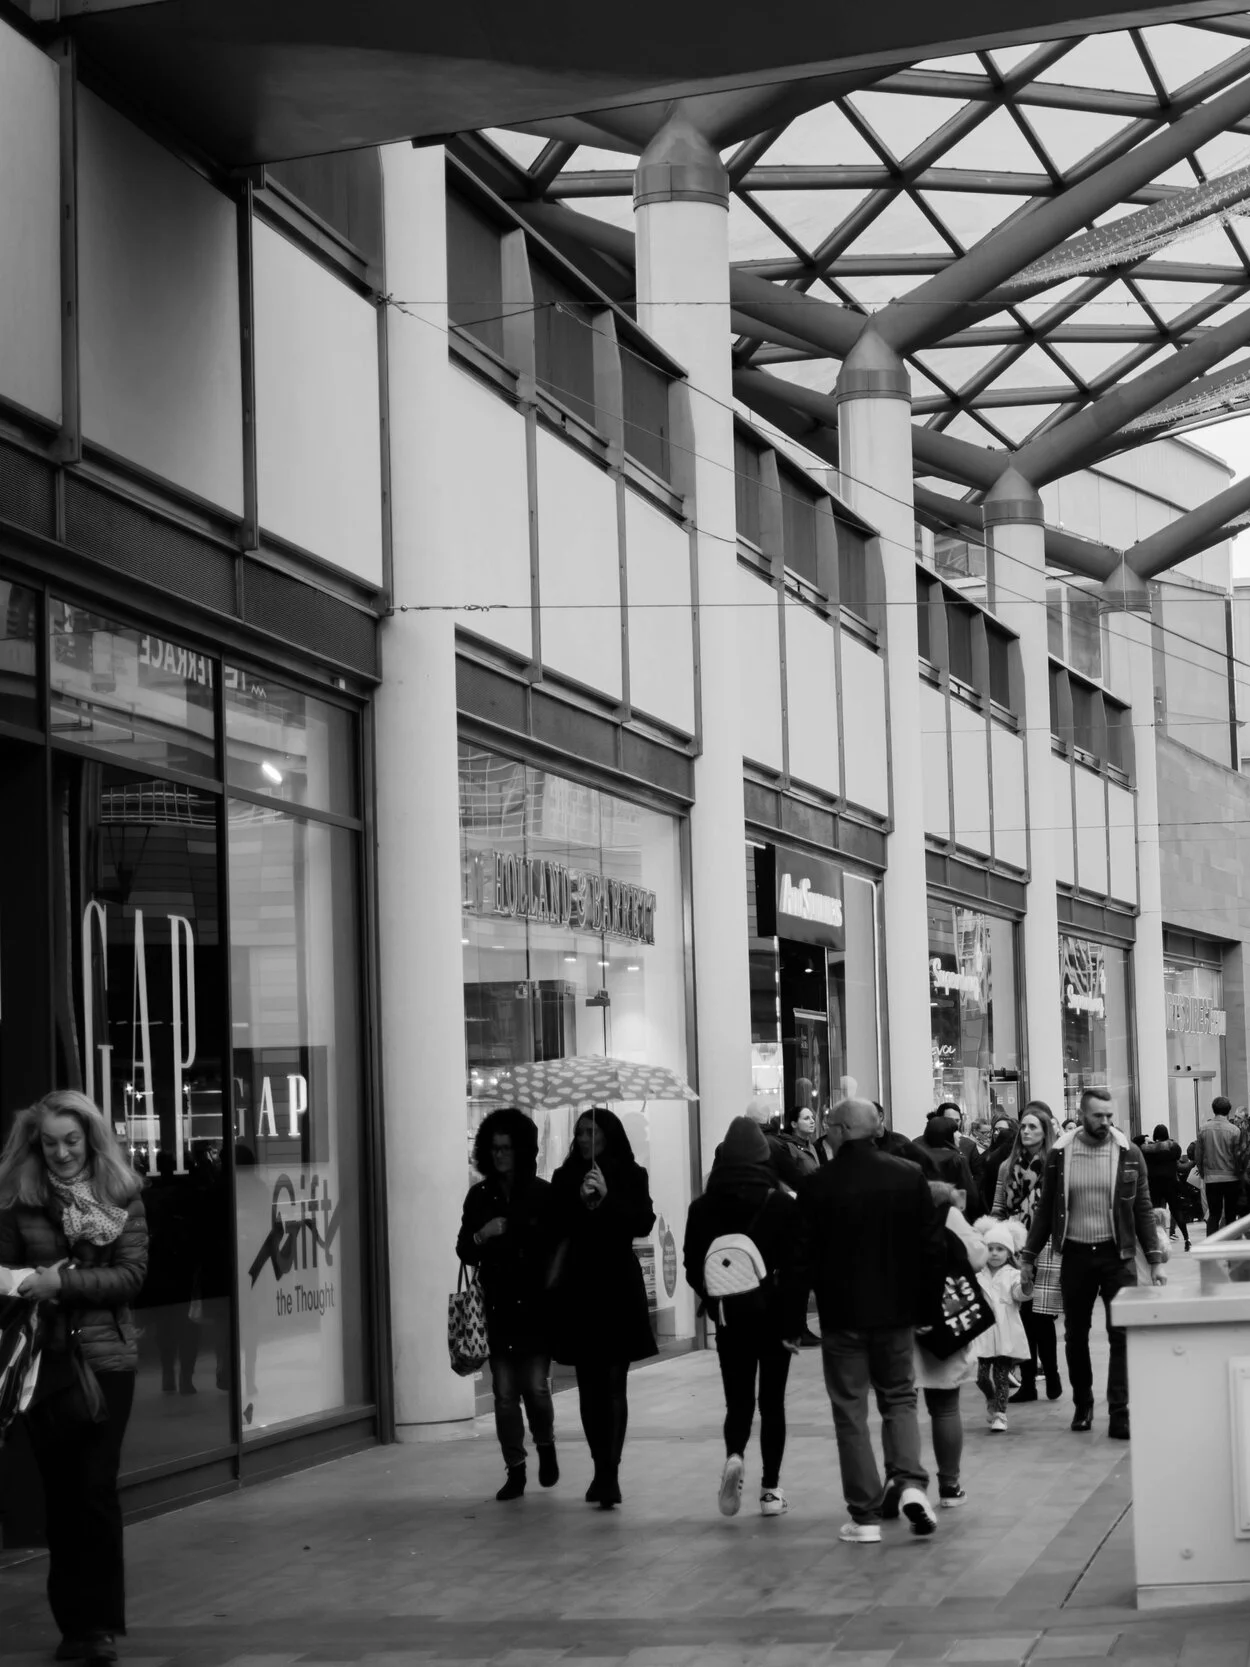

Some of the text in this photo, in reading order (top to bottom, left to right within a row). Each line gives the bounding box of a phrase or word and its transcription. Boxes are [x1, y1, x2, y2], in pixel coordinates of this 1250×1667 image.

[493, 850, 572, 926] HOLLAND
[591, 873, 657, 947] BARRETT
[83, 900, 197, 1177] GAP
[232, 1074, 308, 1137] GAP
[271, 1173, 332, 1275] Gift
[276, 1281, 335, 1317] the Thought
